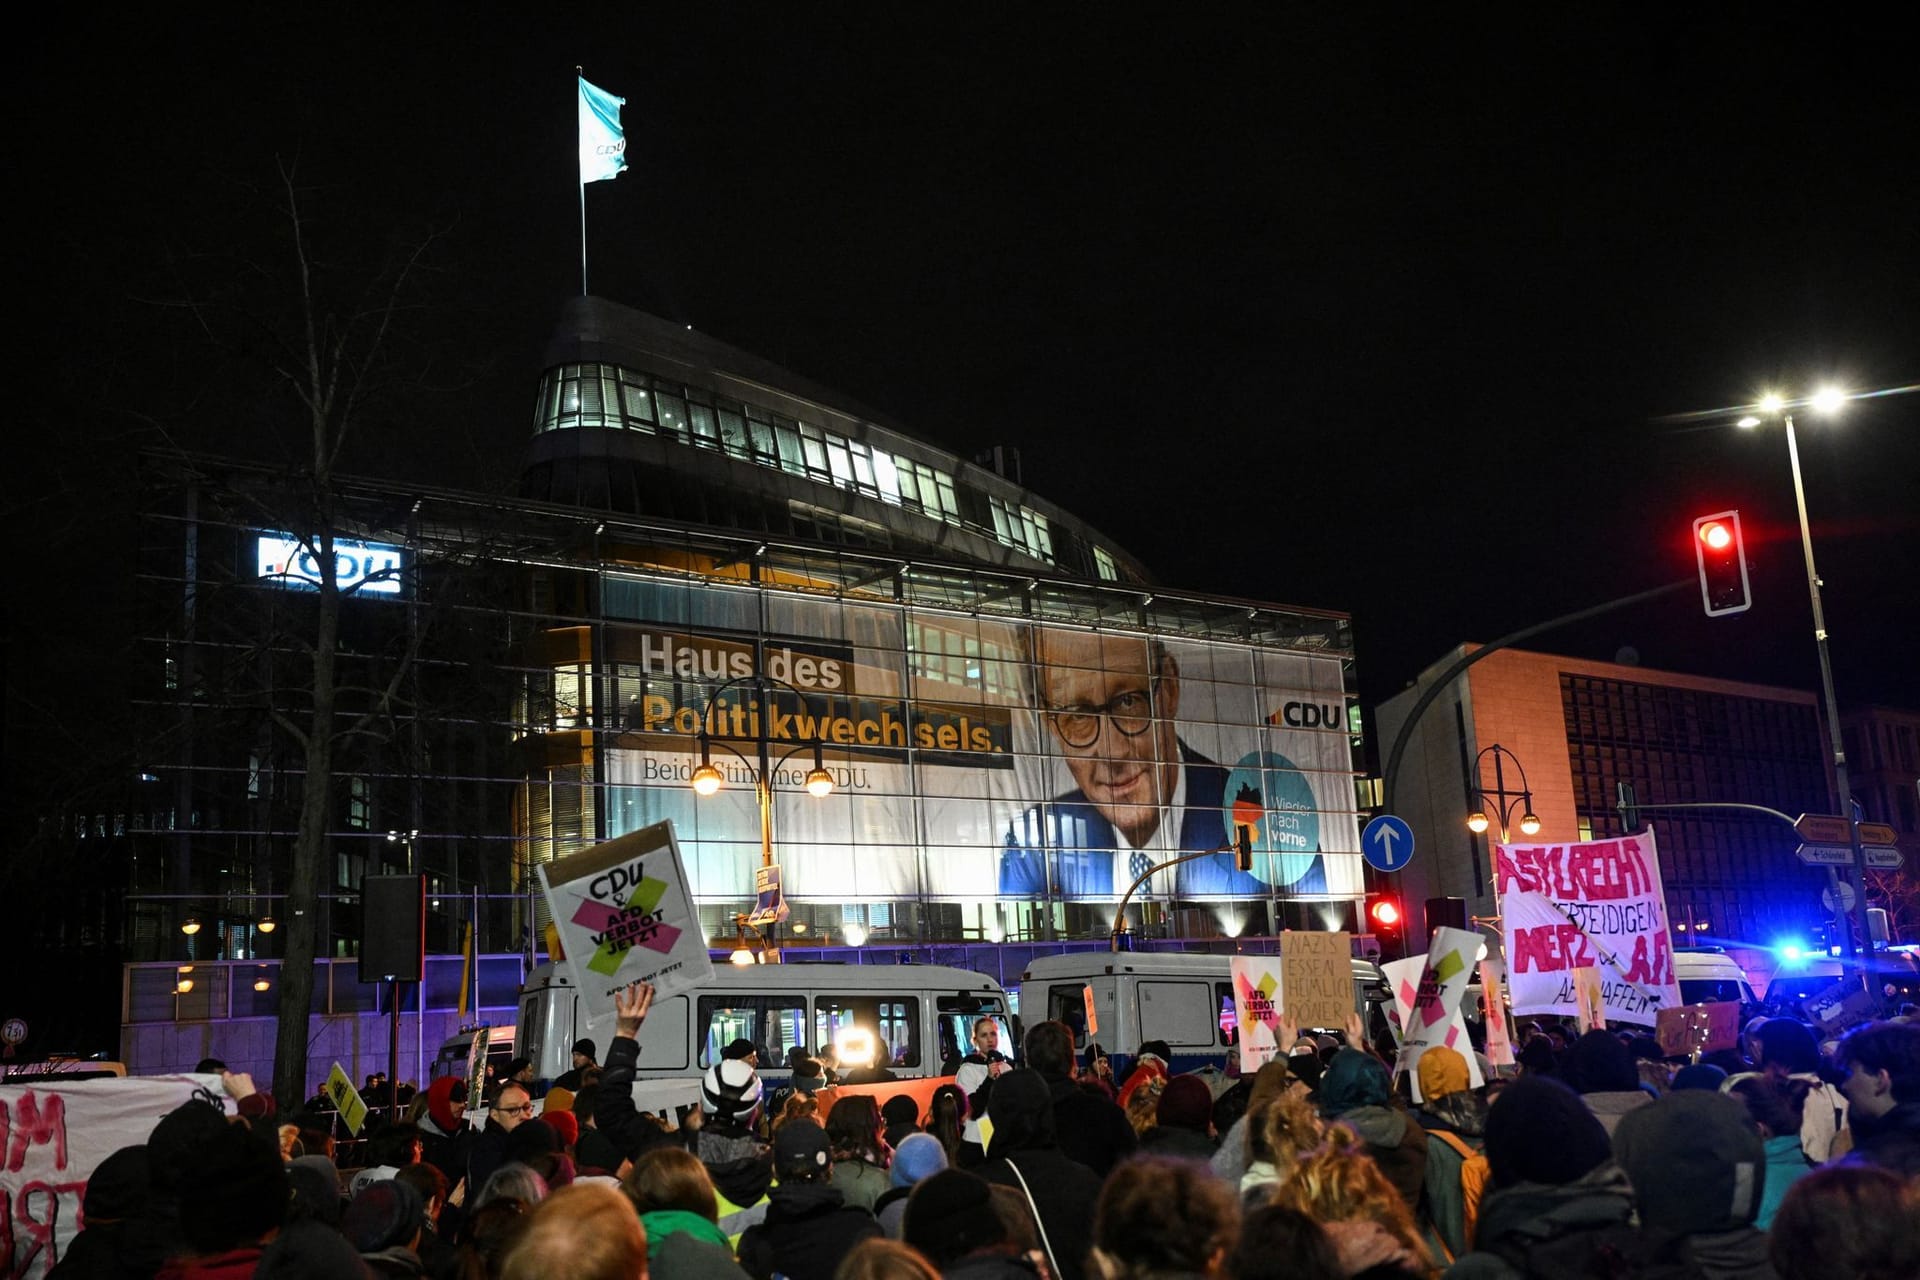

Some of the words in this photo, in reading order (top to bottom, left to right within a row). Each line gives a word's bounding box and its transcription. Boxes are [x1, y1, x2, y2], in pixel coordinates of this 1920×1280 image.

[596, 140, 625, 155] CDU
[299, 552, 393, 580] CDU
[641, 633, 753, 680] Haus
[769, 647, 842, 689] des
[643, 695, 1004, 753] Politikwechsels.
[1283, 701, 1341, 730] CDU
[643, 756, 694, 782] Beid
[1271, 812, 1300, 830] nach
[1271, 829, 1307, 847] vorne
[589, 861, 645, 900] CDU
[1496, 839, 1652, 900] ASYLRECHT
[590, 908, 664, 946] VERBOT
[607, 905, 643, 928] AFD
[607, 924, 659, 956] JETZT
[1289, 934, 1337, 954] NAZIS
[1514, 924, 1595, 973] MERZ
[1288, 958, 1335, 976] ESSEN
[1248, 990, 1265, 1000] AFD
[1287, 977, 1353, 999] HEIMLICH
[1244, 1000, 1275, 1010] VERBOT
[1249, 1011, 1272, 1021] JETZT
[1288, 999, 1342, 1022] DÖNER
